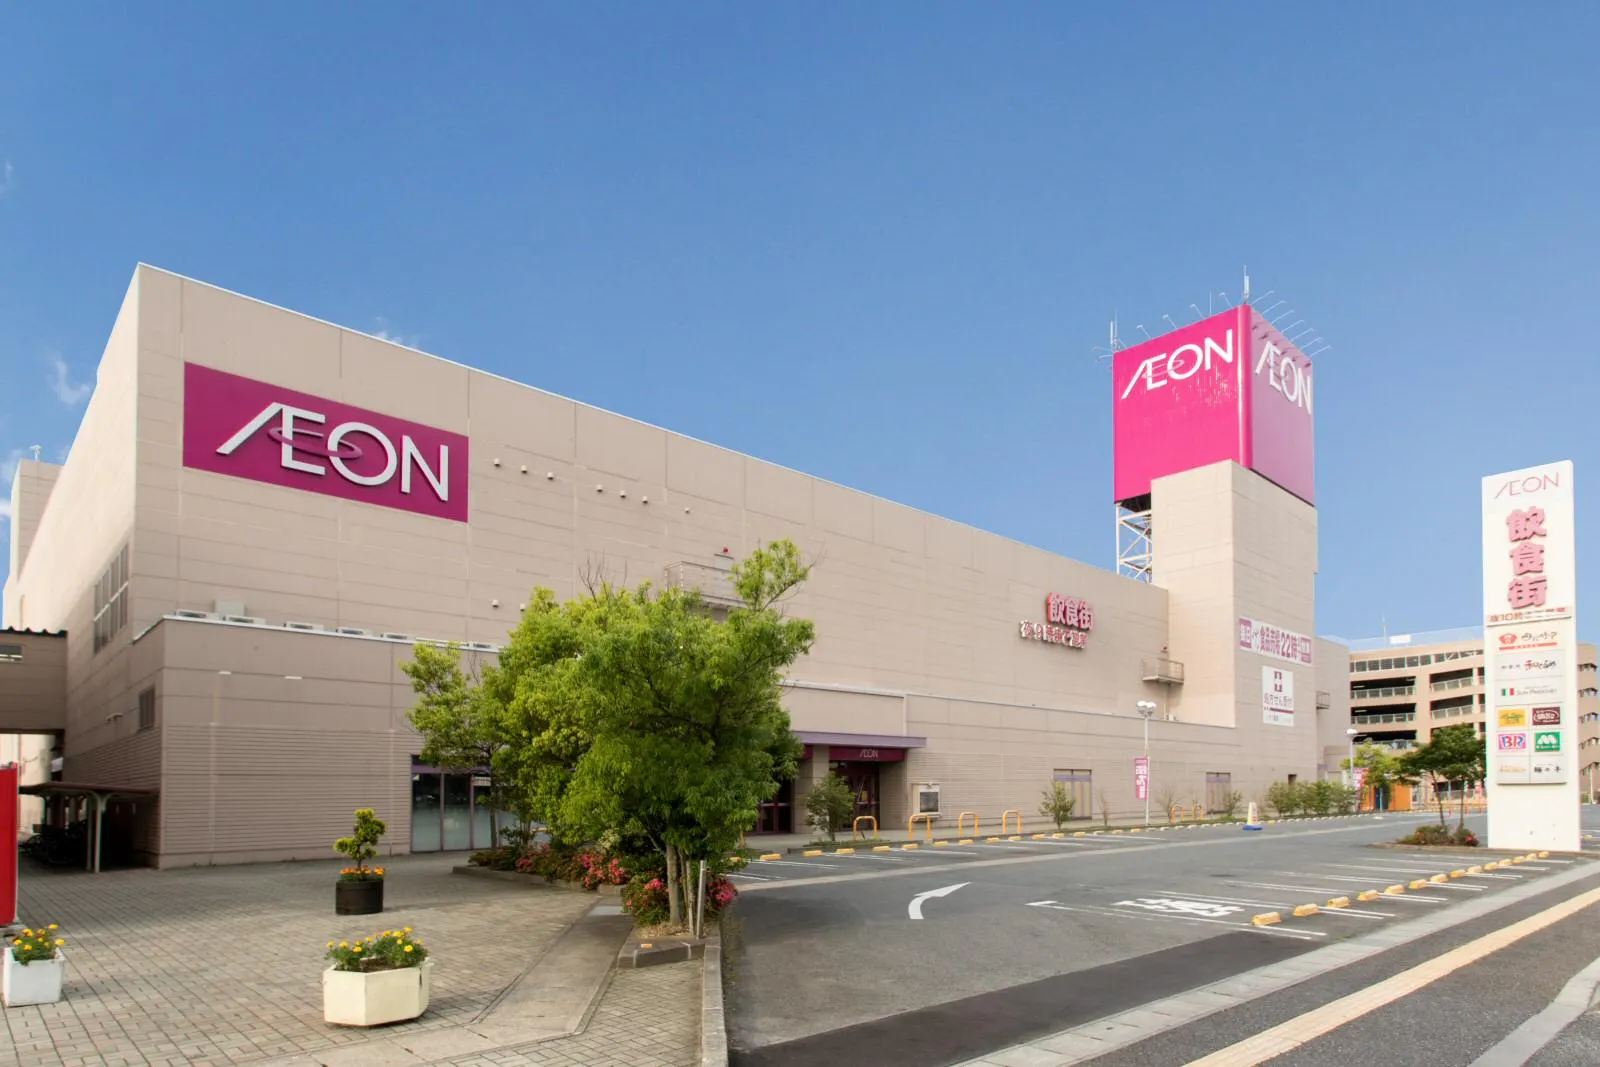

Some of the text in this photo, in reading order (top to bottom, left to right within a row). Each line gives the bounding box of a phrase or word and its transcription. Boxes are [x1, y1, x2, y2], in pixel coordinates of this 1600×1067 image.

[1506, 506, 1547, 609] 飲食街
[1046, 591, 1094, 632] 飲食街
